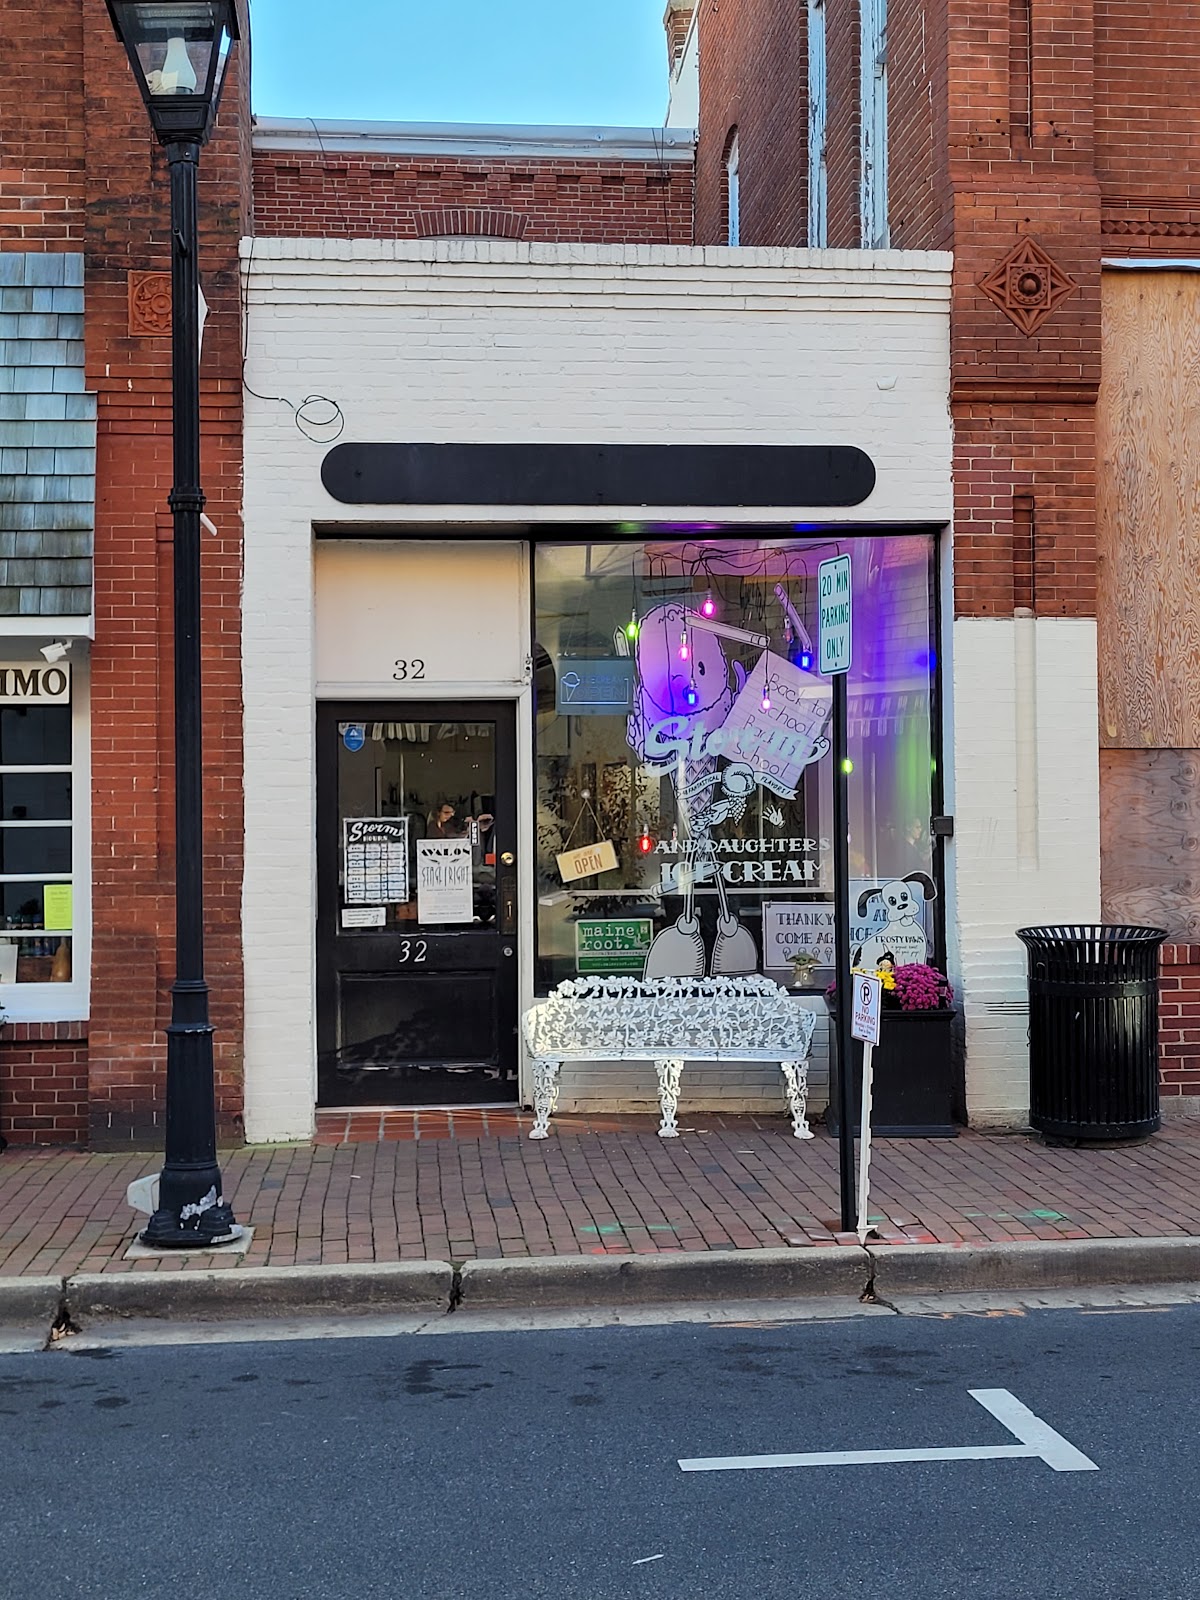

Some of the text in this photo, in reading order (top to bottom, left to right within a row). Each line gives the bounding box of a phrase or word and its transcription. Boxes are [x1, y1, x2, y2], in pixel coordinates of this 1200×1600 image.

[822, 569, 848, 597] 20 MIN
[821, 602, 849, 628] PARKING
[826, 636, 845, 659] ONLY
[392, 659, 426, 681] 32
[768, 672, 827, 718] Back to
[421, 848, 470, 857] AVALON
[653, 836, 831, 854] AND DAUGHTERS
[574, 853, 603, 875] OPEN
[776, 912, 823, 926] THANK
[582, 923, 635, 937] maine
[582, 937, 630, 951] root.
[775, 932, 813, 945] COME
[875, 935, 904, 944] FROSTY
[399, 940, 427, 963] 32
[862, 1005, 869, 1015] NO
[855, 1011, 876, 1026] PARKING
